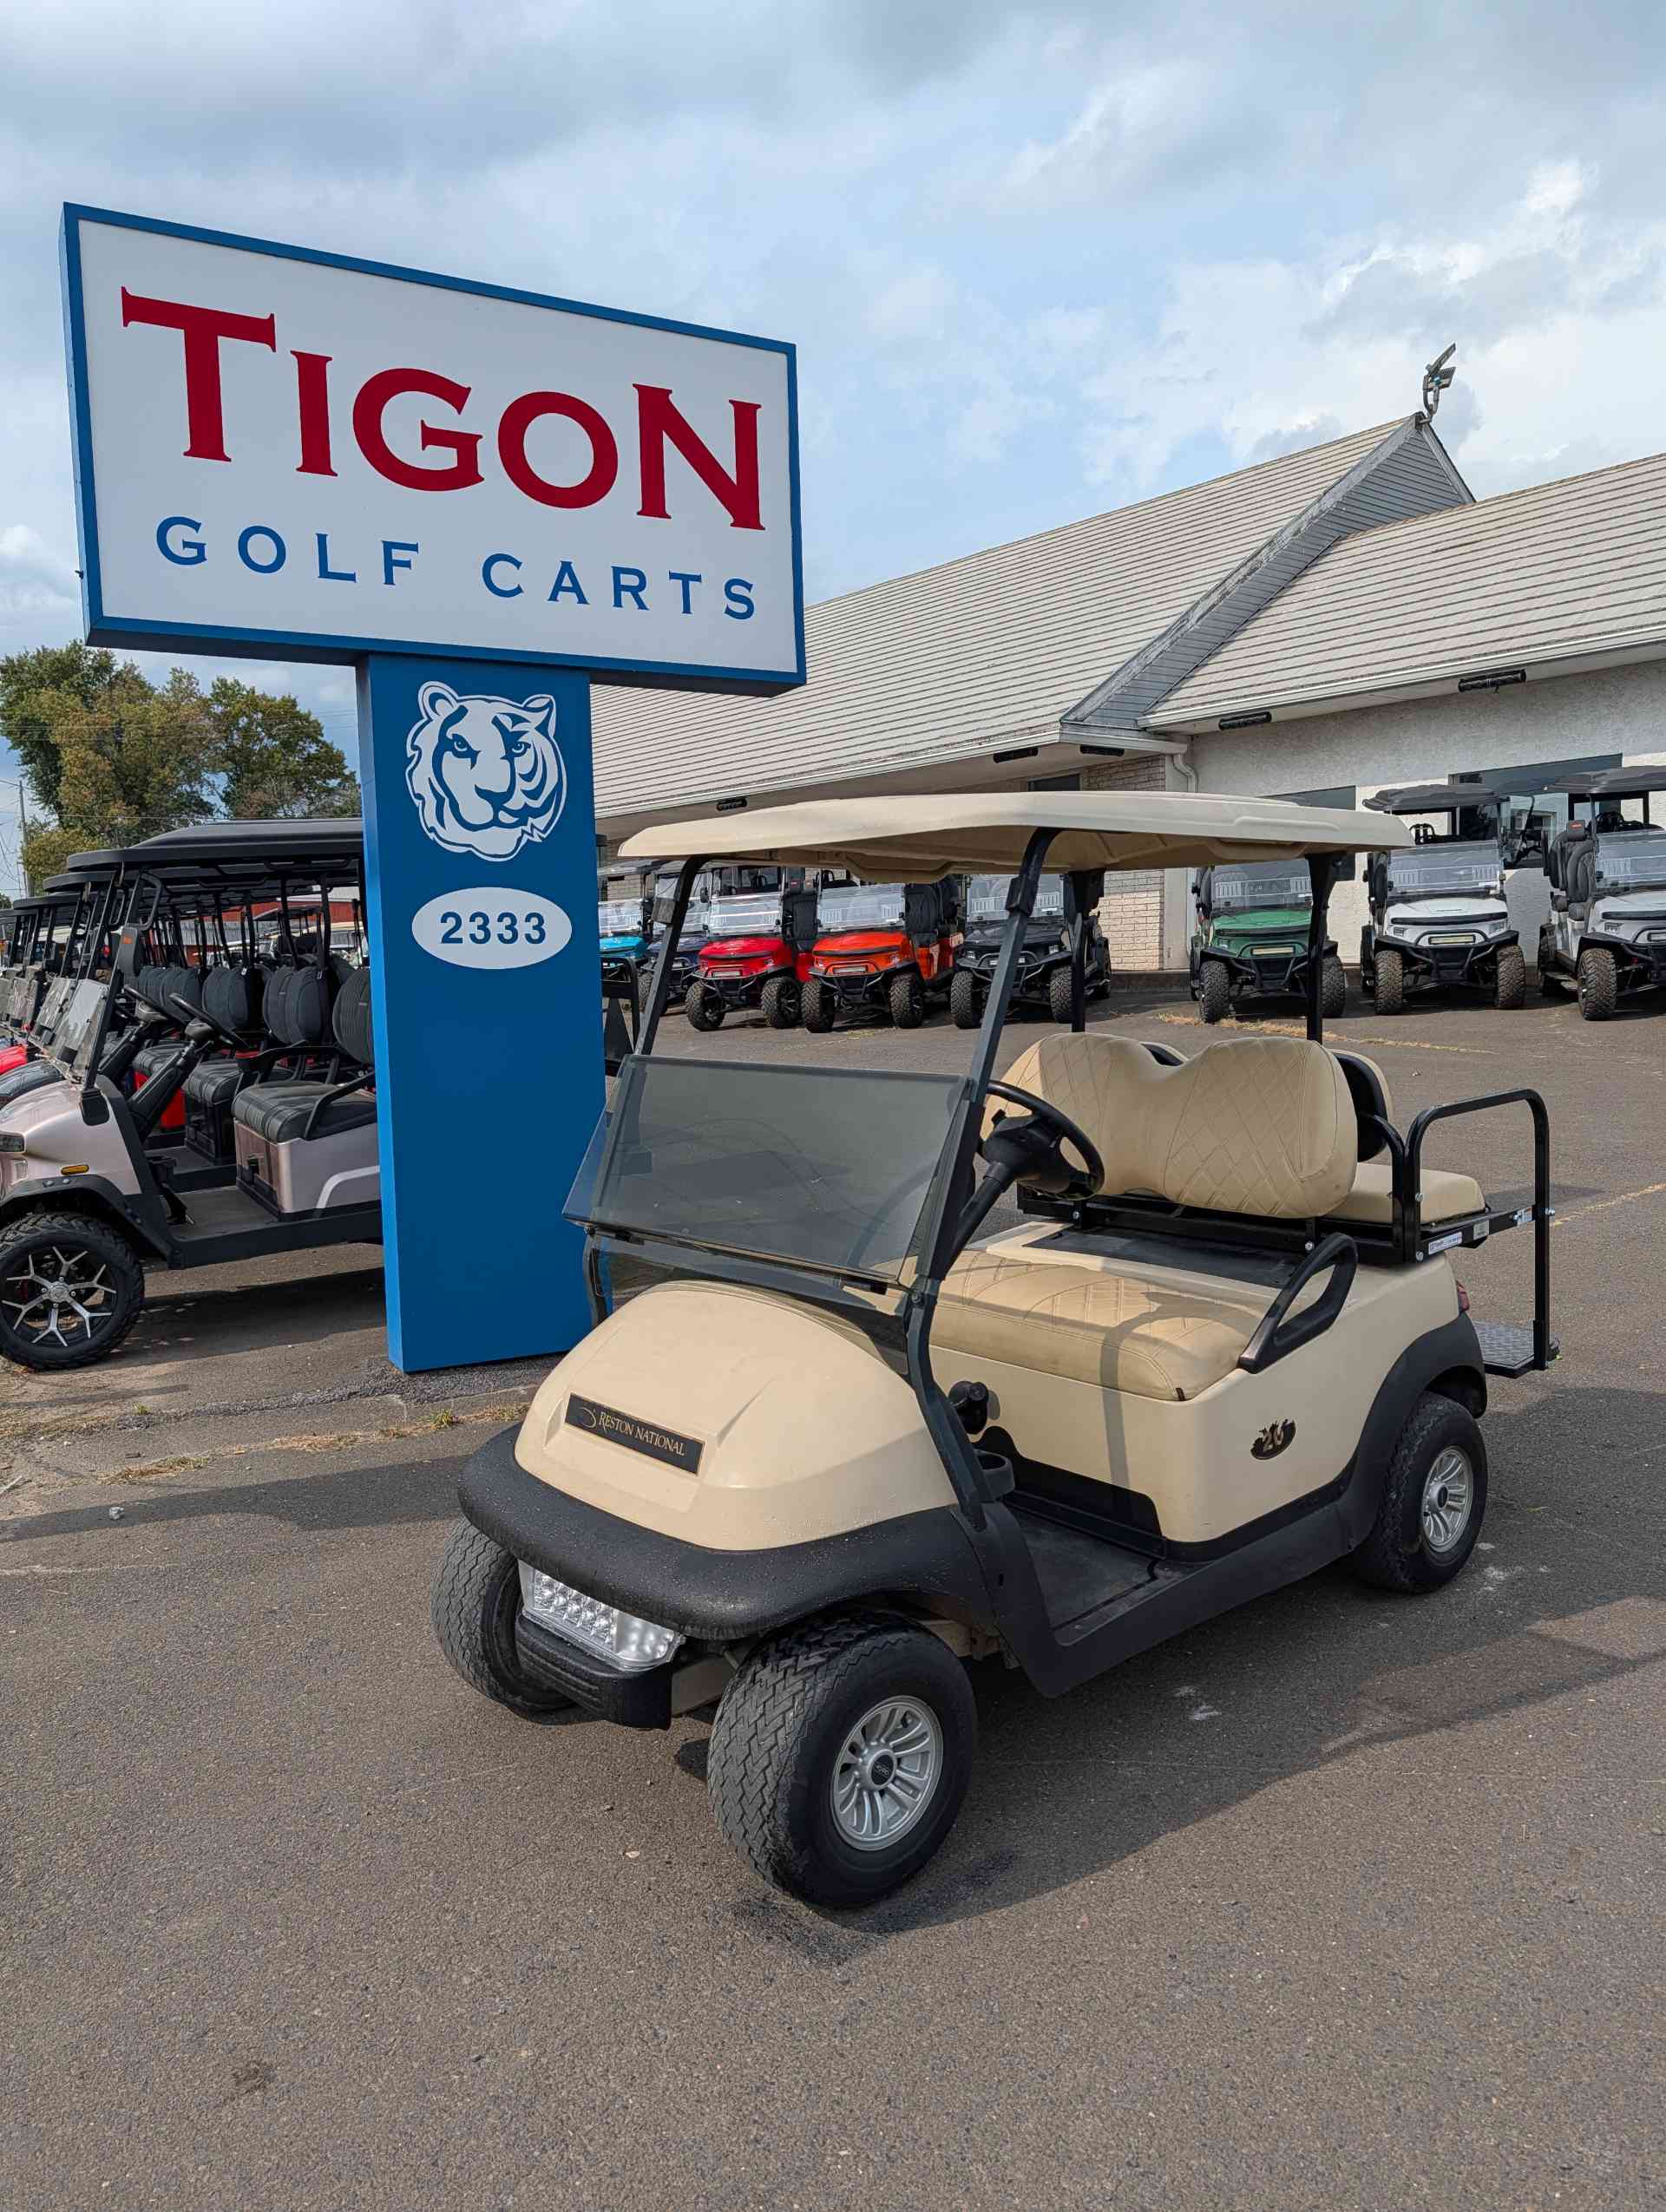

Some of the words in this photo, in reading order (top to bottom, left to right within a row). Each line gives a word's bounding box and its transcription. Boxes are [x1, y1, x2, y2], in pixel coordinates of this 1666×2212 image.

[121, 287, 764, 530] TIGON
[156, 515, 419, 586] GOLF
[482, 553, 755, 620] CARTS
[440, 911, 547, 945] 2333
[599, 1410, 634, 1436] RESTON
[634, 1427, 685, 1456] NATIONAL
